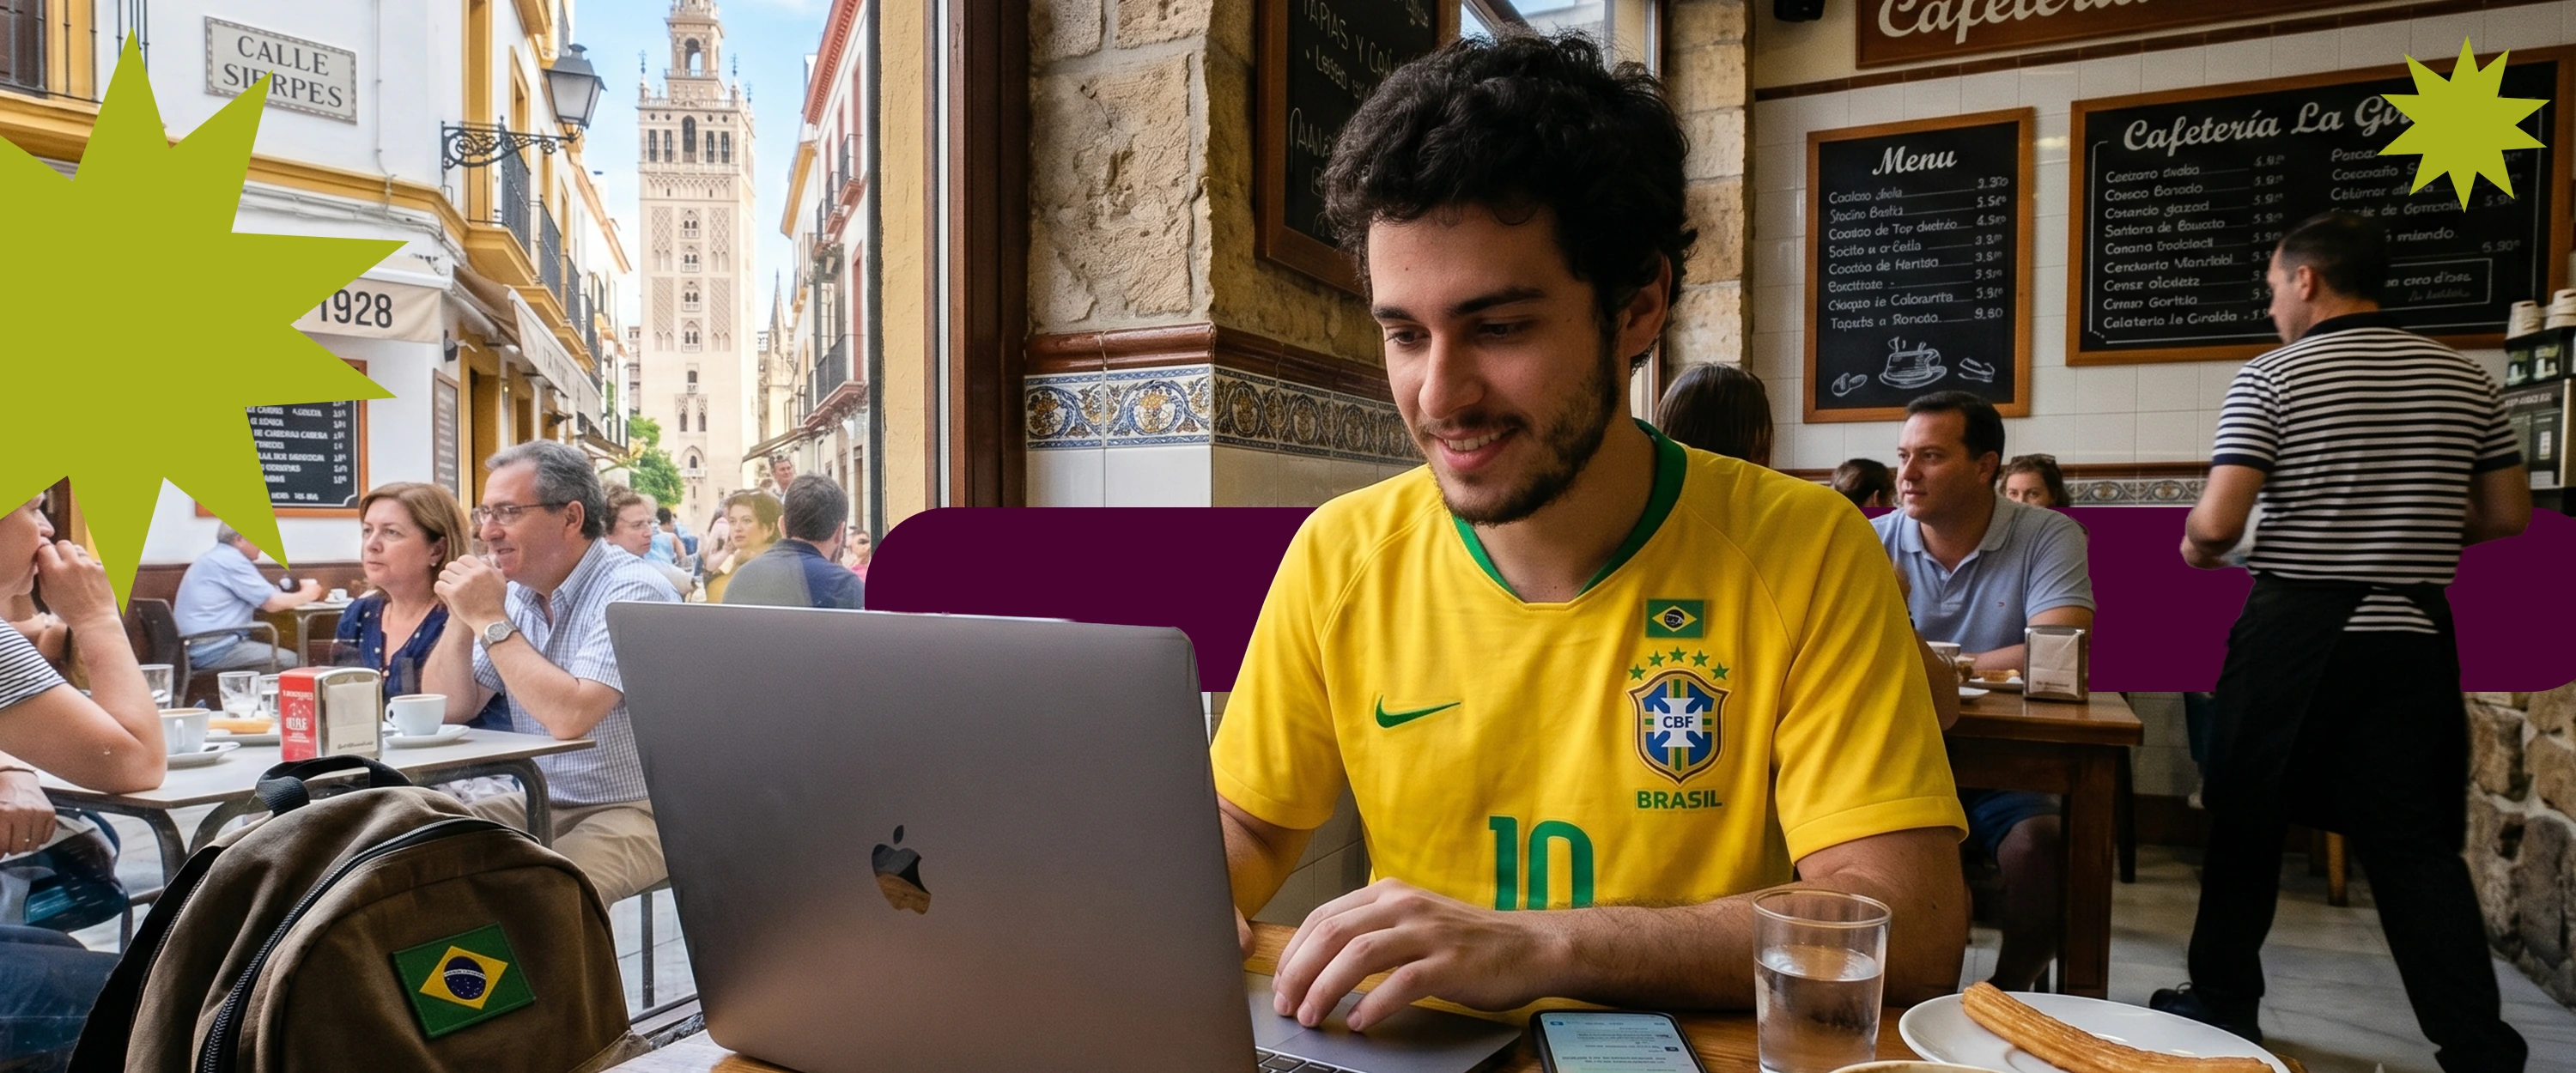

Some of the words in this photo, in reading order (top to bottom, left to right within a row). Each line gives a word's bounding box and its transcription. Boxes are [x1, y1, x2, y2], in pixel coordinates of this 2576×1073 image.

[237, 35, 329, 76] CALLE
[2123, 109, 2281, 157] Cafetería
[2290, 101, 2343, 135] La
[2354, 95, 2415, 136] Gir
[1872, 146, 1958, 175] Menu
[1874, 222, 1890, 236] de
[2157, 221, 2172, 233] de
[1875, 258, 1891, 271] de
[320, 288, 392, 329] 1928
[1662, 716, 1693, 729] CBF
[1637, 791, 1723, 809] BRASIL
[1489, 815, 1595, 912] 10
